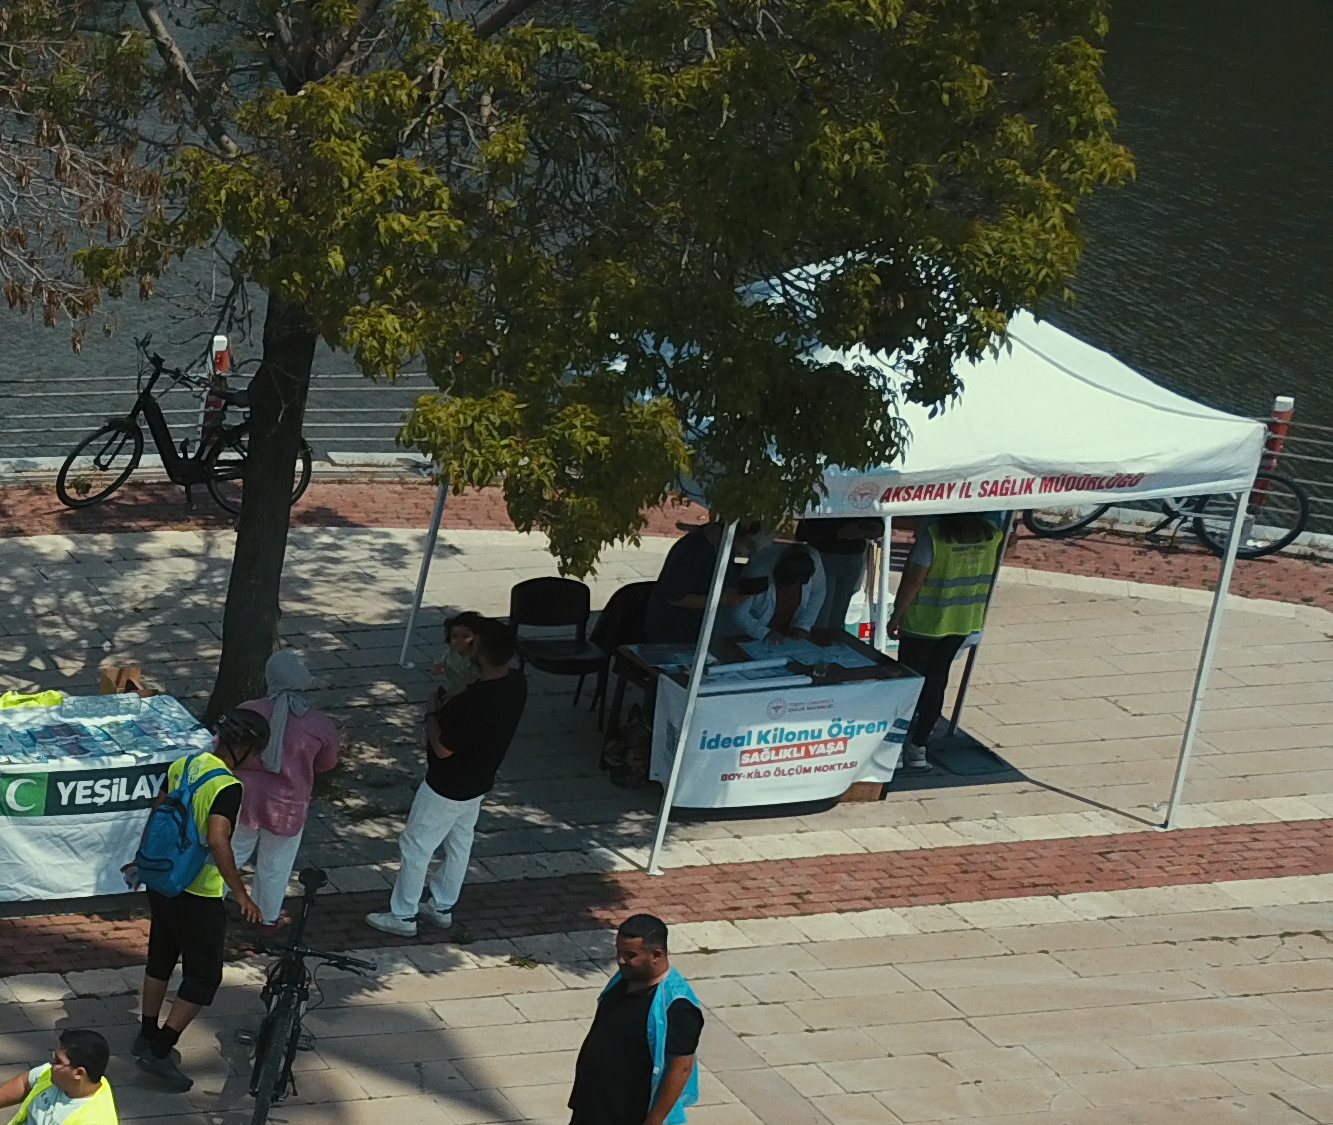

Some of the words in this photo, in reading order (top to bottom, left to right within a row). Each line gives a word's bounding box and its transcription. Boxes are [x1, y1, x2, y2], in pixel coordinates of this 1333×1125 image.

[882, 482, 955, 503] AKSARAY
[958, 480, 974, 499] İL
[978, 476, 1037, 498] SAĞLIK
[1039, 473, 1147, 495] MÜDÜRLÜĞÜ
[700, 729, 753, 750] İdeal
[756, 726, 823, 746] Kilonu
[827, 718, 888, 741] Öğren
[740, 746, 806, 765] SAĞLIKLI
[808, 740, 845, 758] YAŞA
[773, 765, 812, 778] ÖLÇÜM
